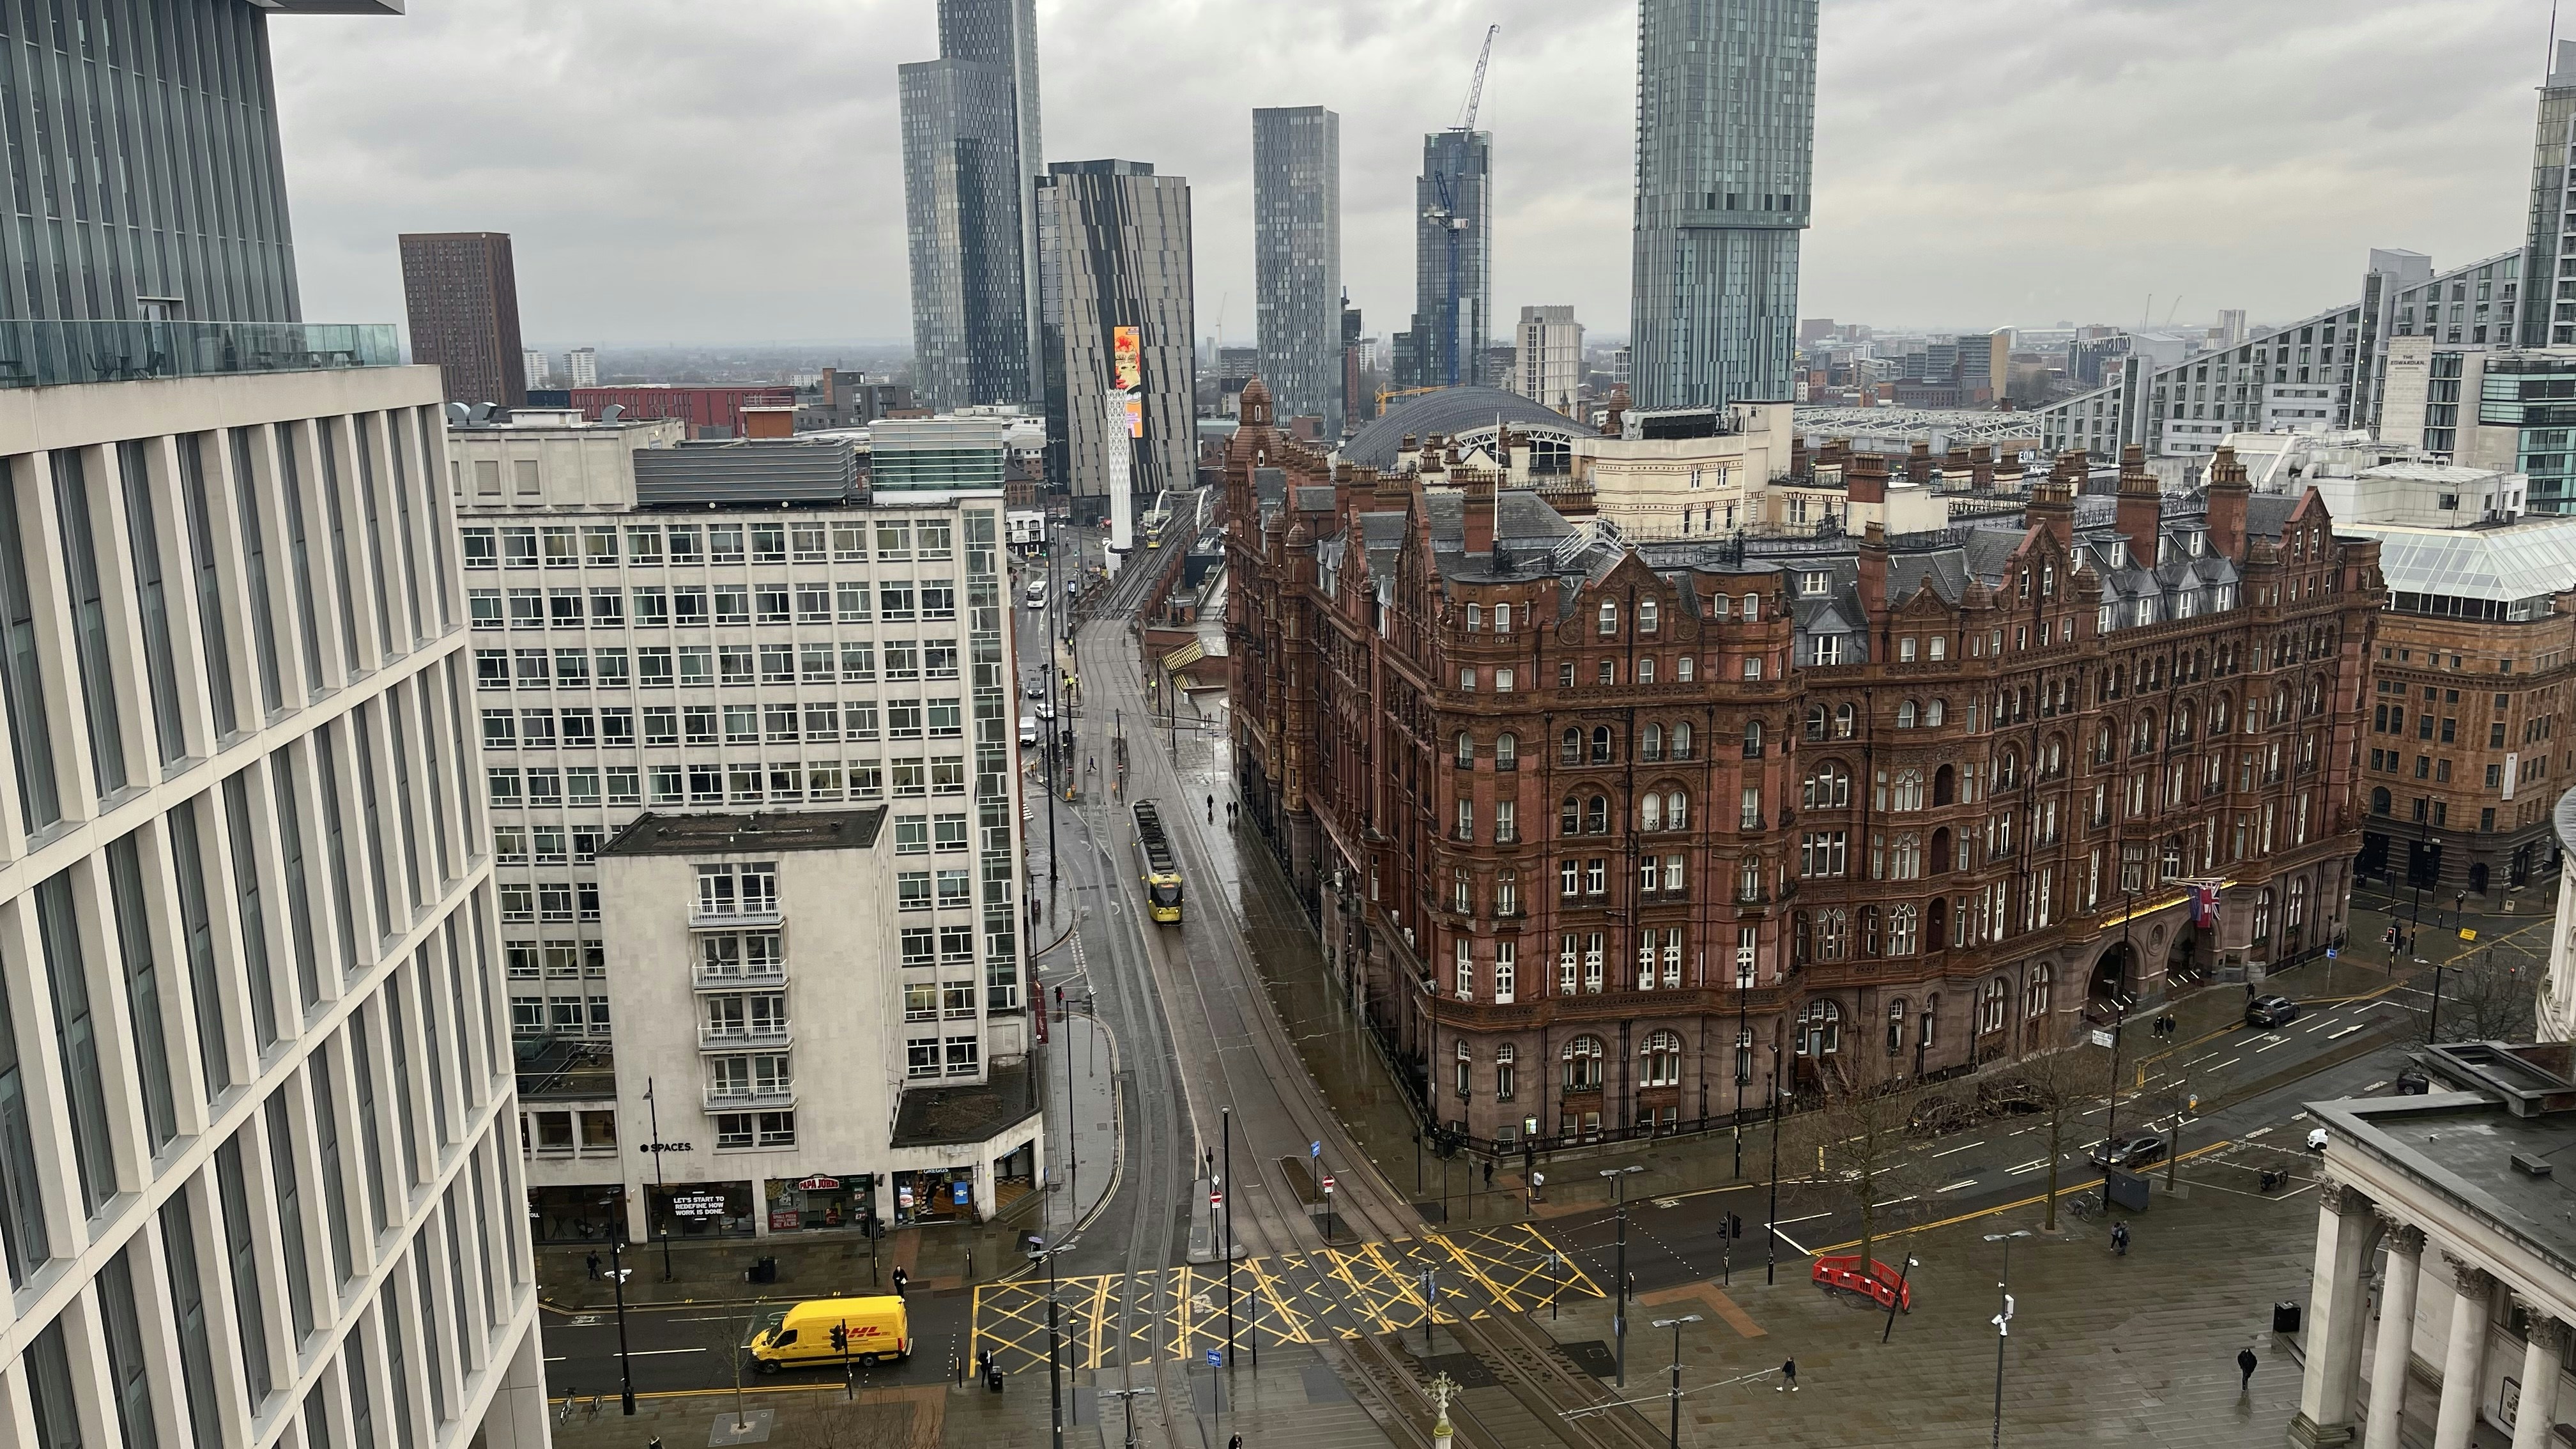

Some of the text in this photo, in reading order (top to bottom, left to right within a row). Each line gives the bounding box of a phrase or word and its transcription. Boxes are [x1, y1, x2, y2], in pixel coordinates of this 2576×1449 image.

[650, 1143, 694, 1152] SPACES.
[800, 1179, 816, 1189] PAPA
[845, 1326, 880, 1338] HL
